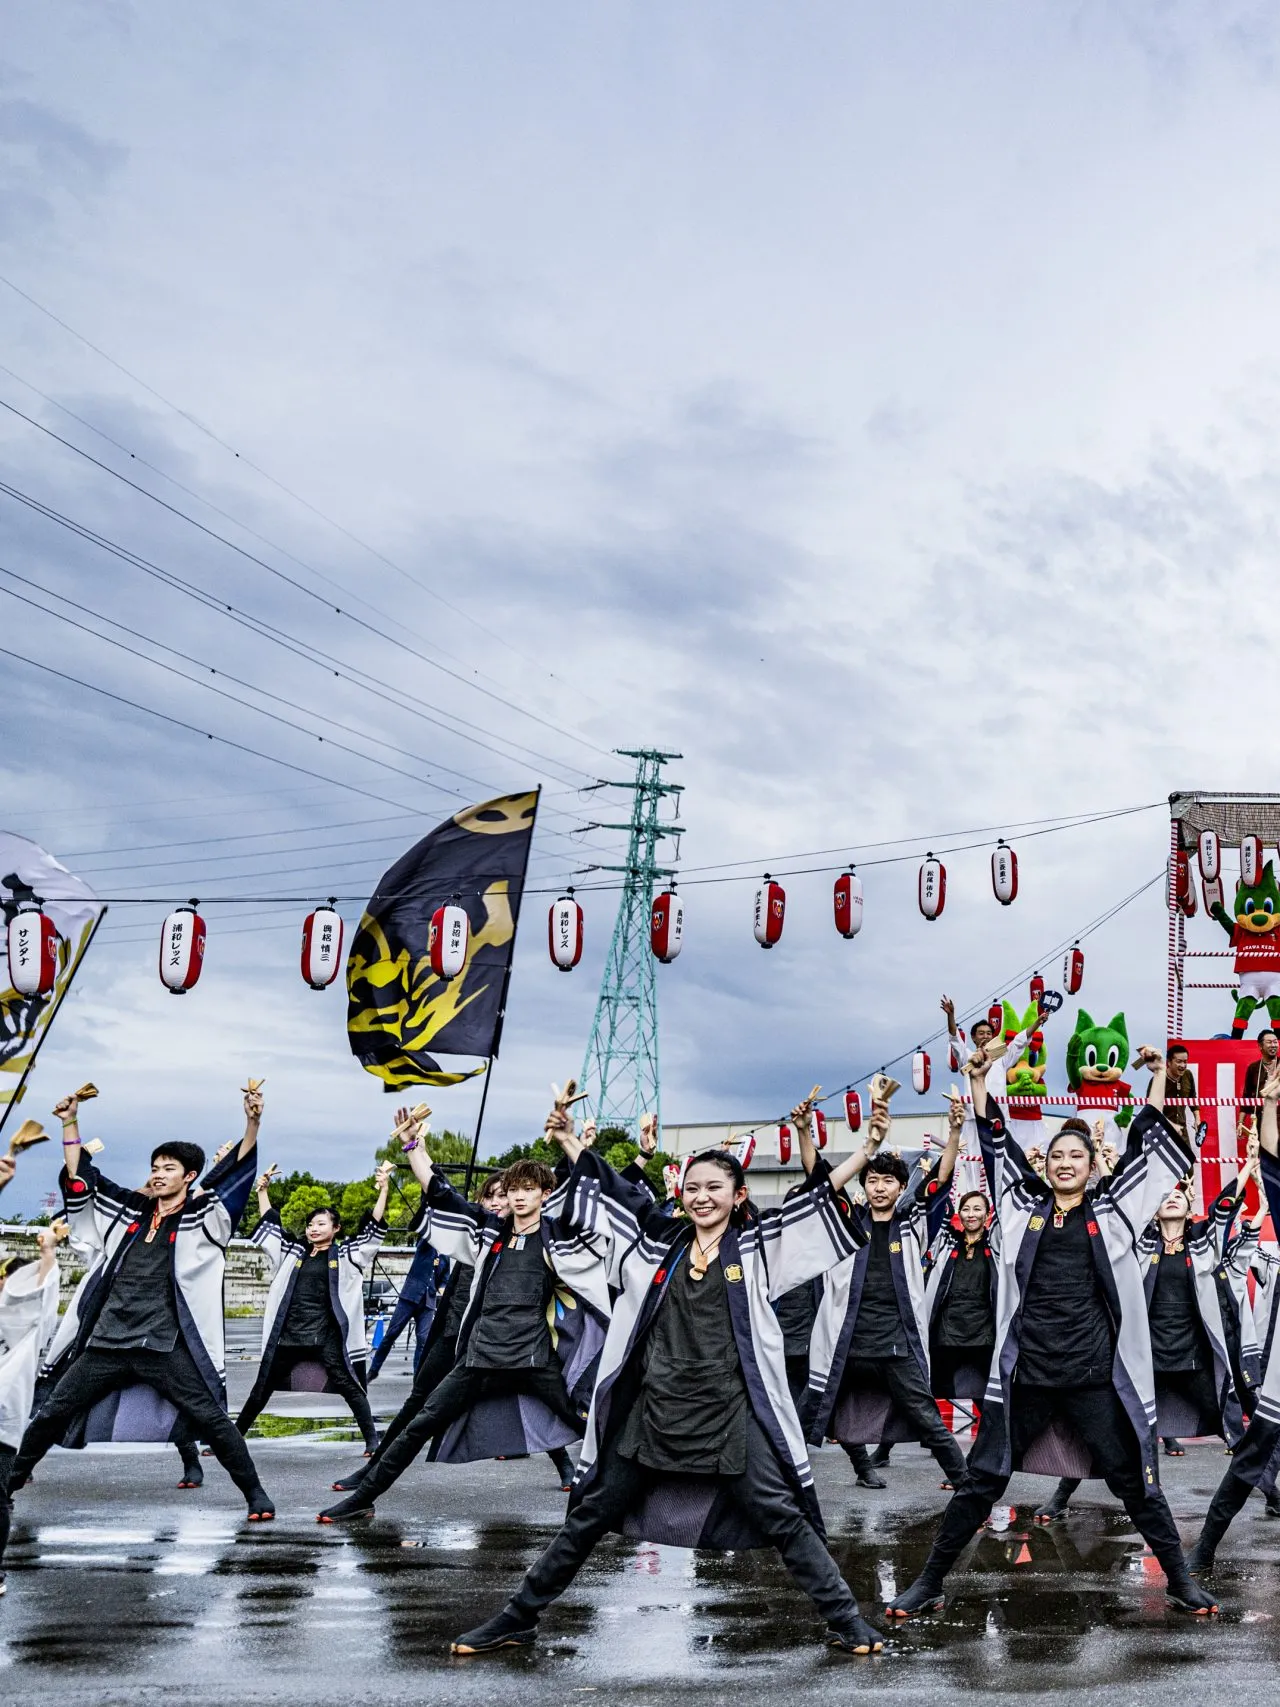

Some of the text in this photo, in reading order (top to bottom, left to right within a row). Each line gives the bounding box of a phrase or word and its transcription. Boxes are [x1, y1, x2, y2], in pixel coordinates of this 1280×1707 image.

[18, 928, 30, 967] サンタナ
[169, 923, 184, 966] 浦和レッズ
[560, 911, 569, 949] 浦和レッズ
